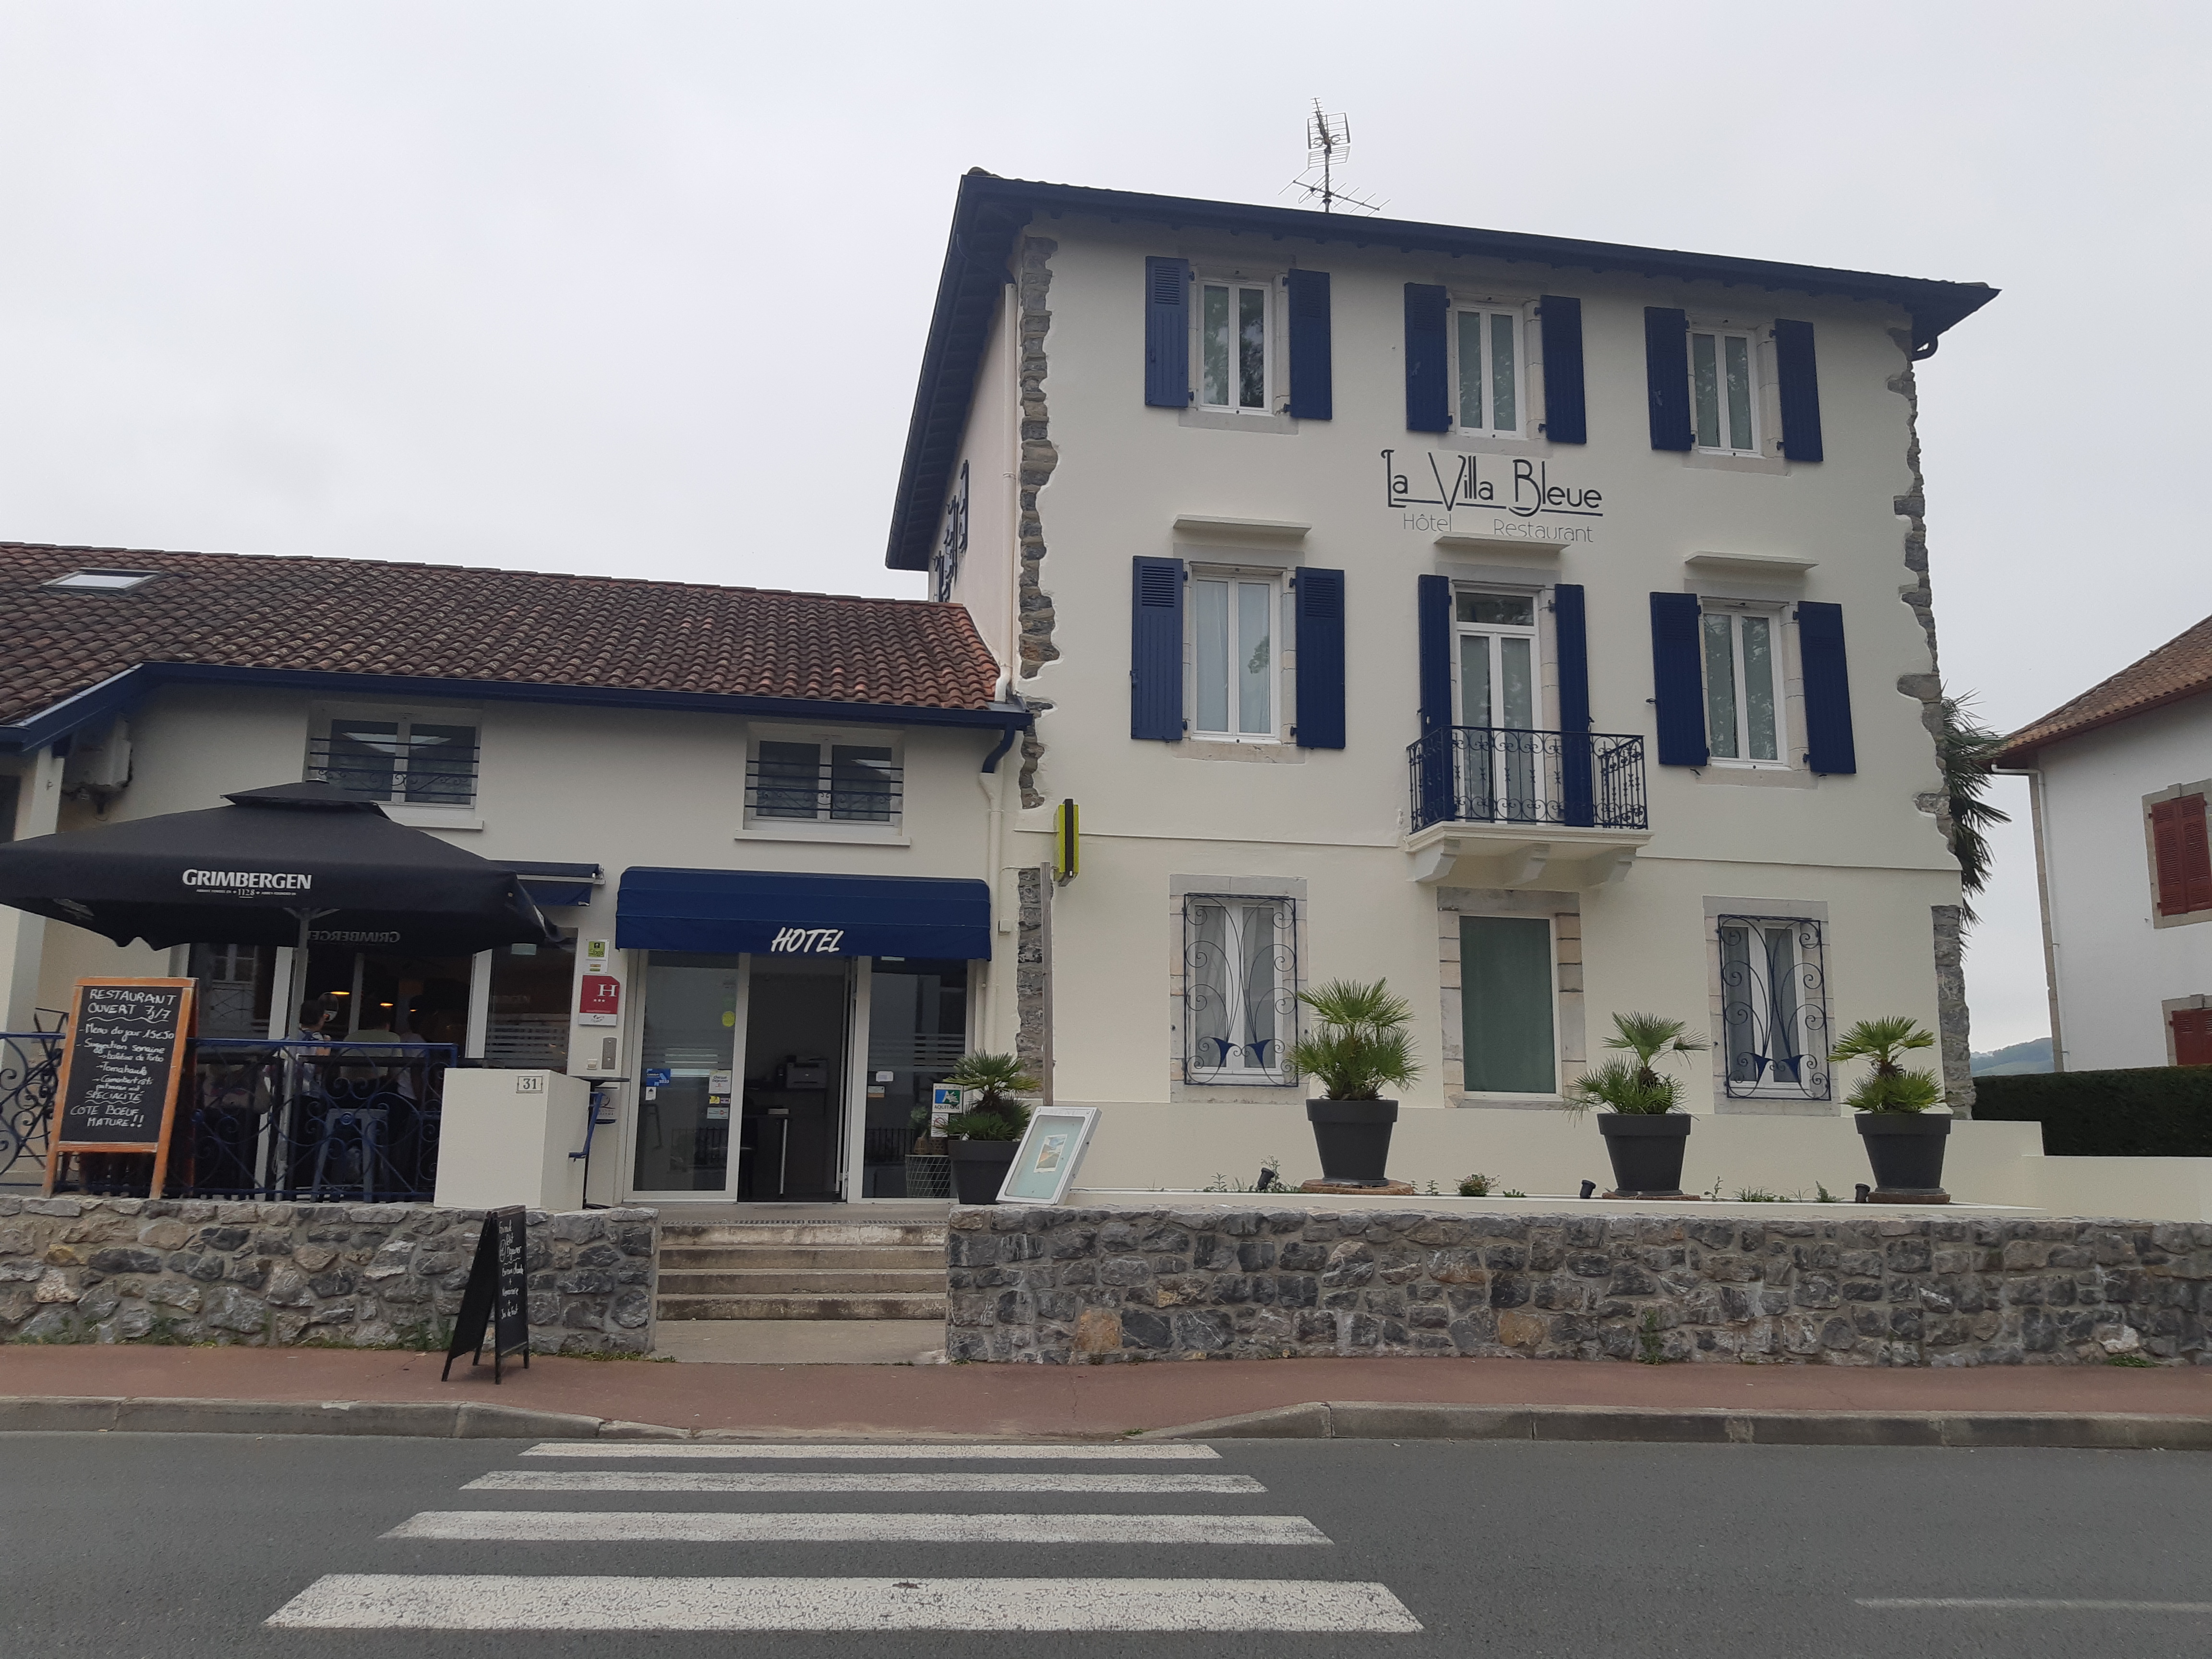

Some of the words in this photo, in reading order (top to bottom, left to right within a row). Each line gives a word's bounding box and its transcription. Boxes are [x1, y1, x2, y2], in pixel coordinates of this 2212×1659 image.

[1381, 449, 1408, 508] La
[1427, 452, 1493, 511] Villa
[1509, 459, 1602, 517] Bleue
[1403, 513, 1452, 532] Hôtel
[1494, 518, 1594, 543] Restaurant
[182, 869, 312, 889] GRIMBERGEN
[770, 926, 844, 952] HOTEL
[90, 989, 177, 1005] RESTAURANT
[597, 984, 618, 997] H
[87, 1002, 137, 1014] OUVERT
[523, 1078, 537, 1089] 31
[70, 1105, 99, 1115] COTE
[105, 1105, 140, 1116] BOEUF
